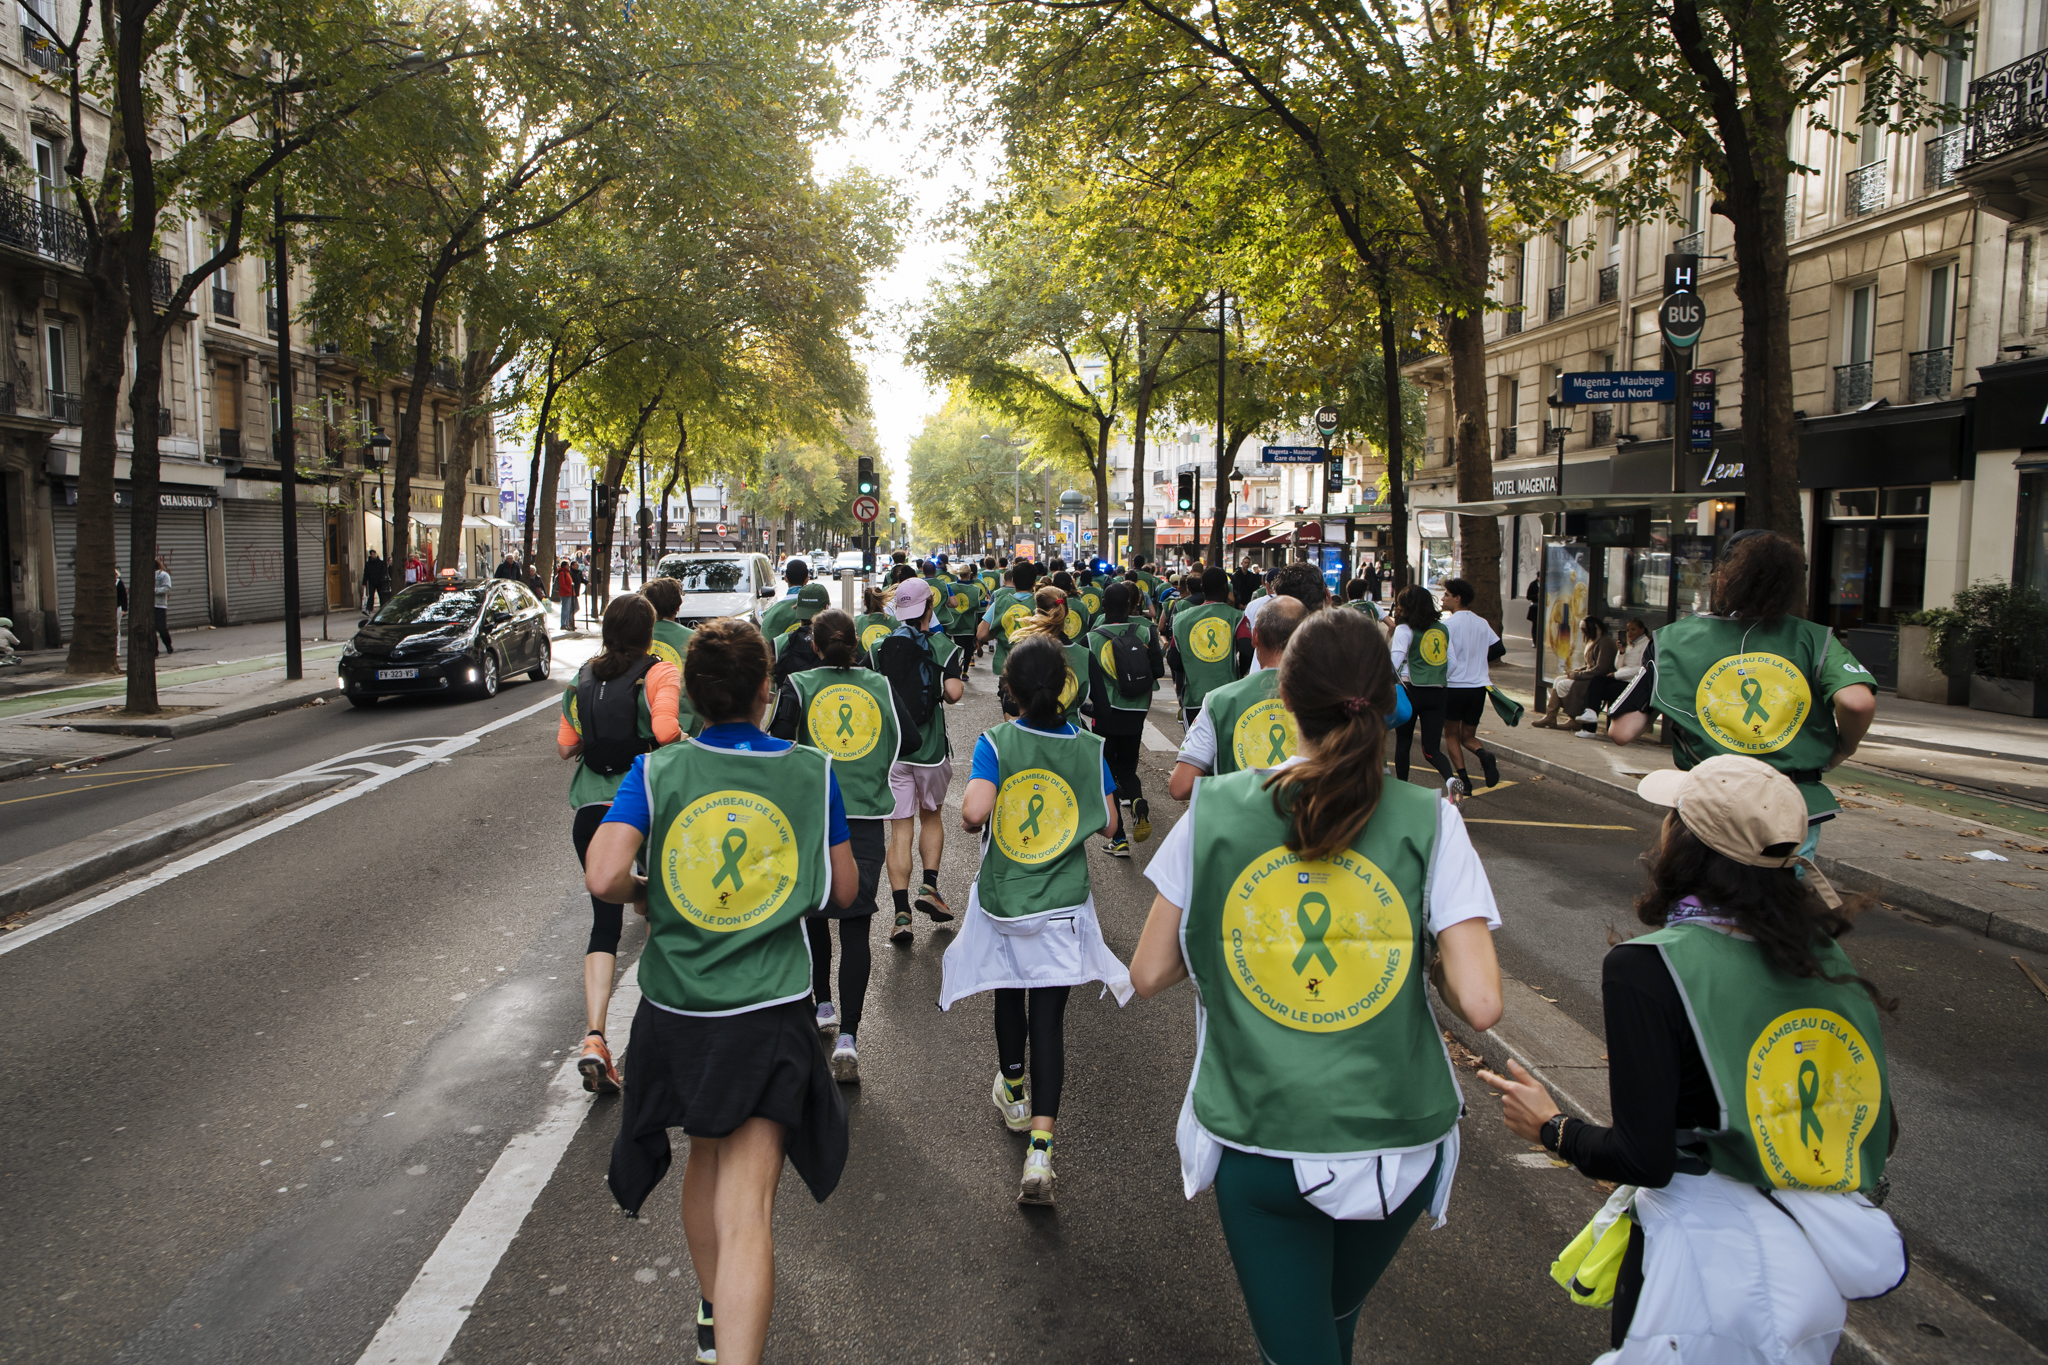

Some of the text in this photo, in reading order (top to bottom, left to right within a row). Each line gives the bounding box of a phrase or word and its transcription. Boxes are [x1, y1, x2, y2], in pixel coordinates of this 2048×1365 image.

[1668, 306, 1699, 323] BUS
[1573, 378, 1611, 389] Magenta
[1620, 376, 1665, 387] Maubeuge
[1585, 388, 1653, 399] Gare du Nord
[1695, 372, 1711, 385] 56
[1320, 412, 1337, 423] BUS
[159, 494, 213, 507] CHAUSSURES
[1493, 476, 1557, 496] HOTEL MAGENTA
[1704, 679, 1714, 691] LE
[1757, 656, 1771, 664] DE
[1771, 659, 1783, 670] LA
[1784, 666, 1798, 680] VIE
[815, 699, 822, 707] LE
[820, 687, 852, 700] FLAMBEAU
[861, 693, 869, 701] LA
[811, 718, 821, 742] COURSE
[820, 741, 835, 755] POUR
[1240, 720, 1249, 729] LE
[1702, 701, 1805, 750] COURSE POUR LE DON D'ORGANES
[1004, 784, 1013, 792] LE
[1012, 773, 1050, 786] FLAMBEAU
[1050, 778, 1061, 787] DE
[1059, 786, 1068, 796] LA
[1066, 795, 1074, 808] VIE
[680, 815, 694, 829] LE
[693, 797, 753, 818] FLAMBEAU
[754, 803, 770, 816] DE
[768, 813, 783, 828] LA
[778, 826, 790, 845] VIE
[999, 834, 1011, 853] POUR
[1010, 849, 1019, 857] LE
[1020, 852, 1037, 860] DON
[668, 848, 789, 925] COURSE POUR LE DON D'ORGANES
[1238, 882, 1255, 901] LE
[1332, 855, 1354, 871] DE
[1353, 865, 1373, 885] LA
[1372, 882, 1393, 907] VIE
[1231, 928, 1401, 1024] COURSE POUR LE DON D'ORGANES
[1752, 1062, 1762, 1081] LE
[1757, 1018, 1817, 1061] FLAMBEAU
[1820, 1019, 1837, 1034] DE
[1835, 1027, 1848, 1044] LA
[1848, 1040, 1865, 1065] VIE
[1755, 1114, 1785, 1174] COURSE
[1824, 1175, 1850, 1192] DON
